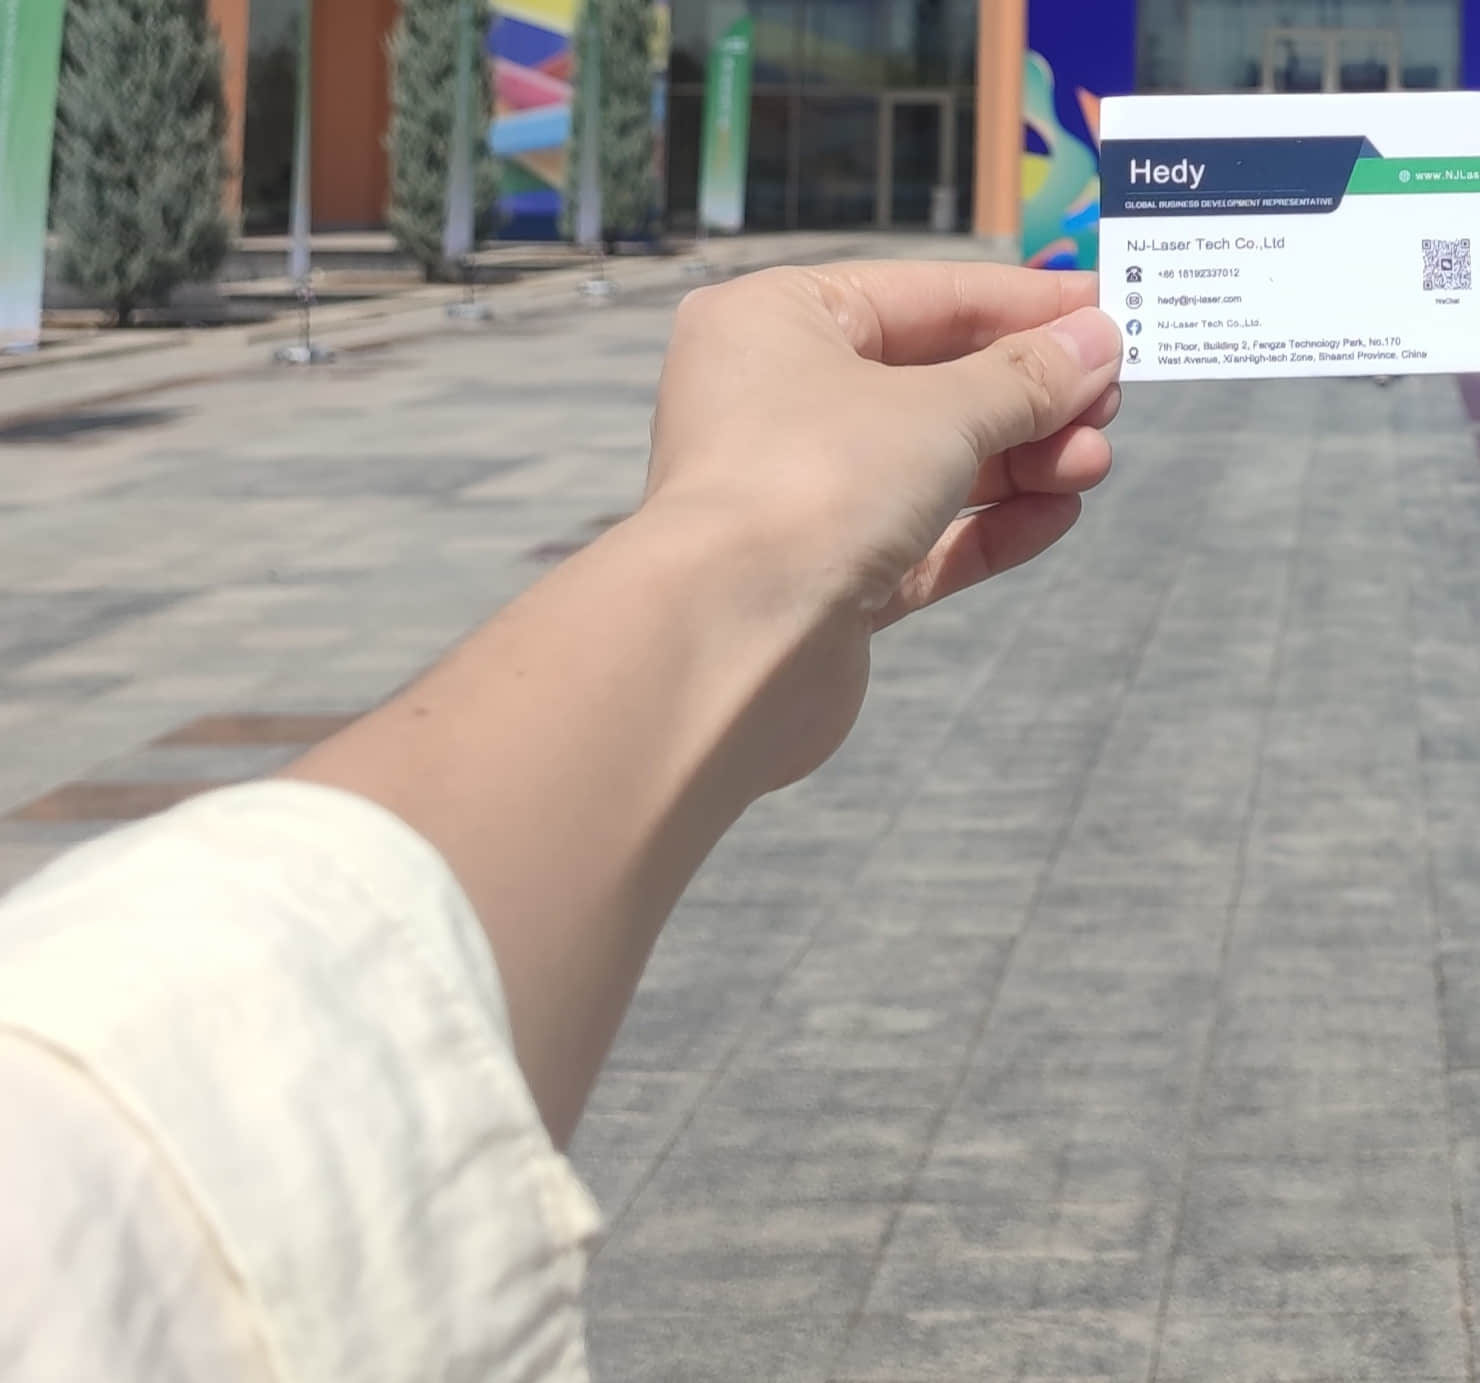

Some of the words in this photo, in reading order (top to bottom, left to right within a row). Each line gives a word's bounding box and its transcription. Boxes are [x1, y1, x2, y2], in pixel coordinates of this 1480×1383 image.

[1129, 158, 1205, 190] Hedy
[1125, 200, 1157, 209] GLOBAL
[1158, 200, 1199, 209] BUSINESS
[1200, 199, 1262, 208] DEVELOPMENT
[1262, 197, 1333, 207] REPRESENTATIVE
[1127, 239, 1191, 252] NJ-Laser
[1195, 238, 1230, 251] Tech
[1235, 237, 1285, 251] Co.,Ltd
[1157, 269, 1175, 279] +86
[1157, 295, 1242, 307] hedy@nj-laser.com
[1157, 320, 1198, 329] NJ-Laser
[1201, 319, 1223, 328] Tech
[1174, 342, 1200, 352] Floor,
[1203, 341, 1239, 352] Building
[1241, 341, 1250, 351] 2,
[1289, 339, 1340, 350] Technology
[1369, 337, 1401, 346] No.170
[1158, 356, 1181, 365] West
[1184, 356, 1221, 365] Avenue,
[1290, 352, 1316, 362] Zone,
[1401, 350, 1427, 359] China
